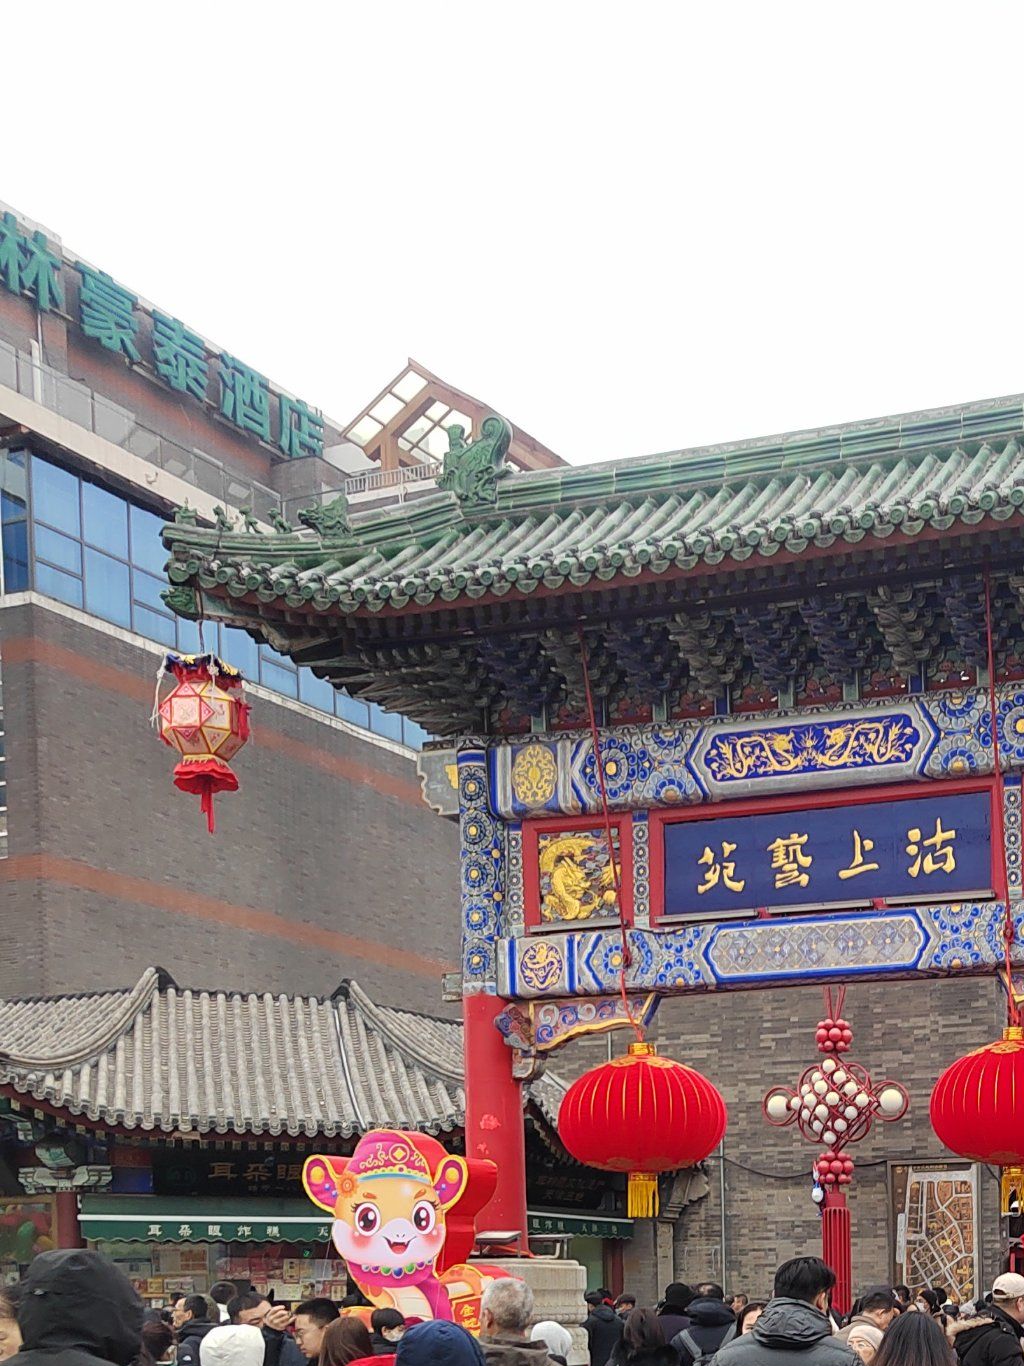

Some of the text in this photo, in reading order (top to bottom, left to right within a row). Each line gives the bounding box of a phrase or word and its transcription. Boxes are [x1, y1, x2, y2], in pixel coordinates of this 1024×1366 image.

[0, 211, 324, 458] 林豪泰酒店
